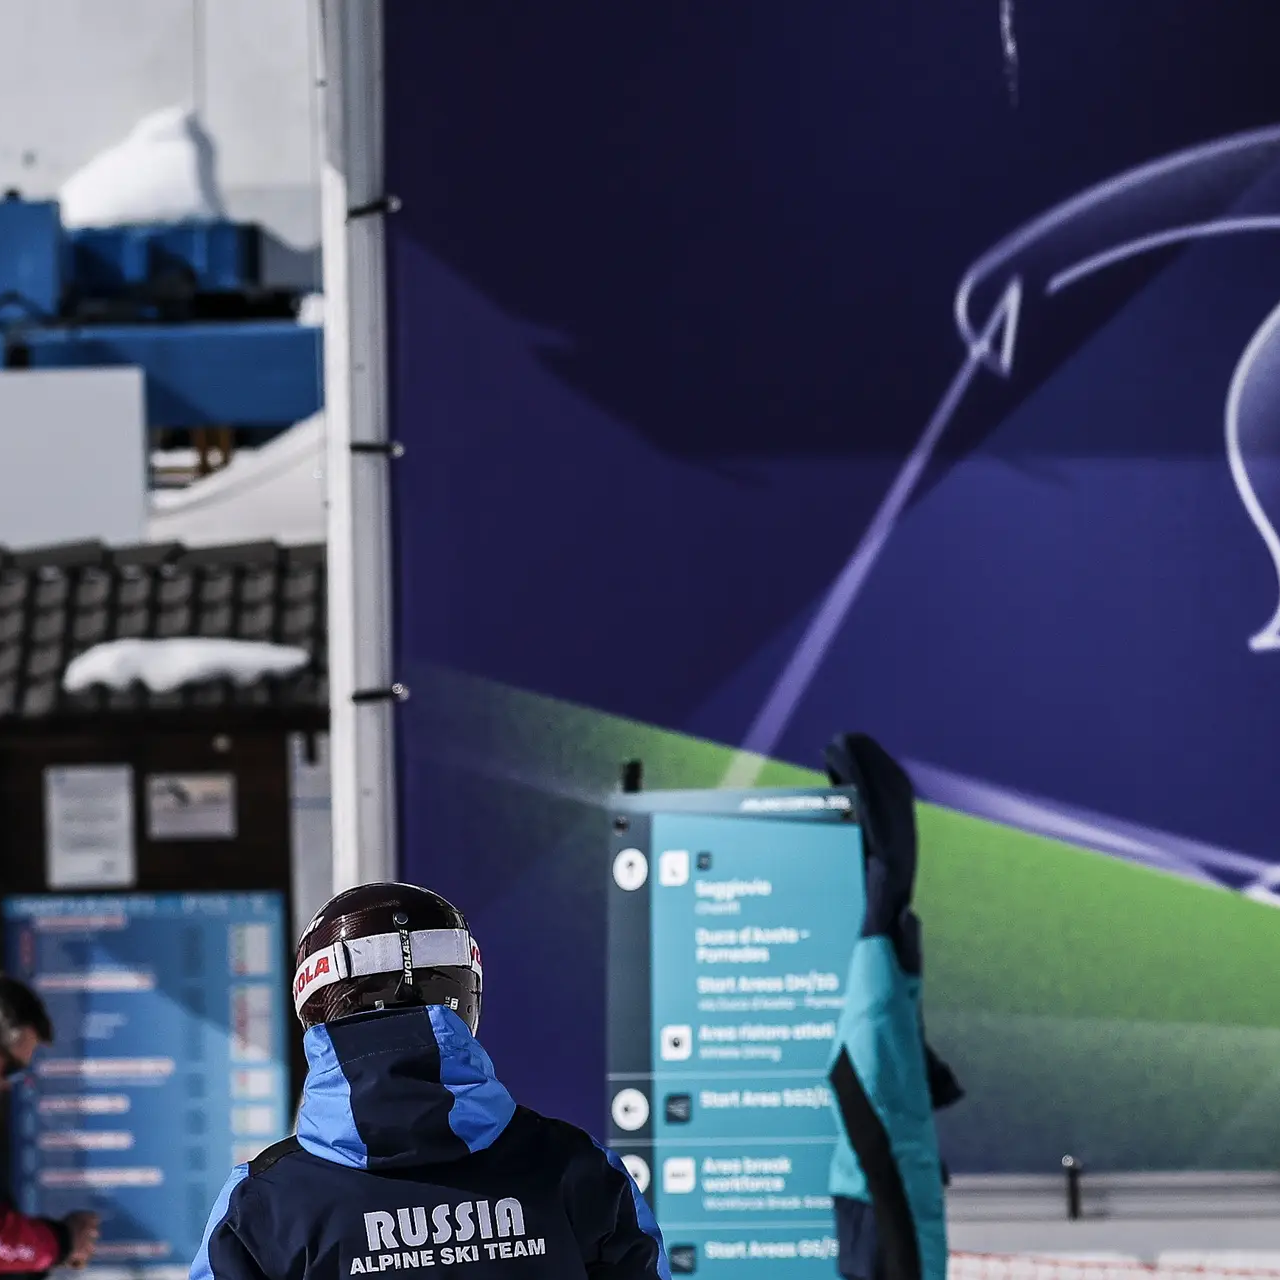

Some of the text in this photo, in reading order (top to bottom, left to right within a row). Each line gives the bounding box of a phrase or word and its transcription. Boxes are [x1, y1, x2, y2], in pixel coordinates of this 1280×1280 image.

[697, 977, 736, 993] Start
[699, 1025, 736, 1041] Area
[700, 1091, 739, 1108] Start
[702, 1158, 741, 1175] Area
[363, 1197, 526, 1252] RUSSIA
[350, 1238, 546, 1276] ALPINE SKI TEAM
[704, 1242, 744, 1259] Start
